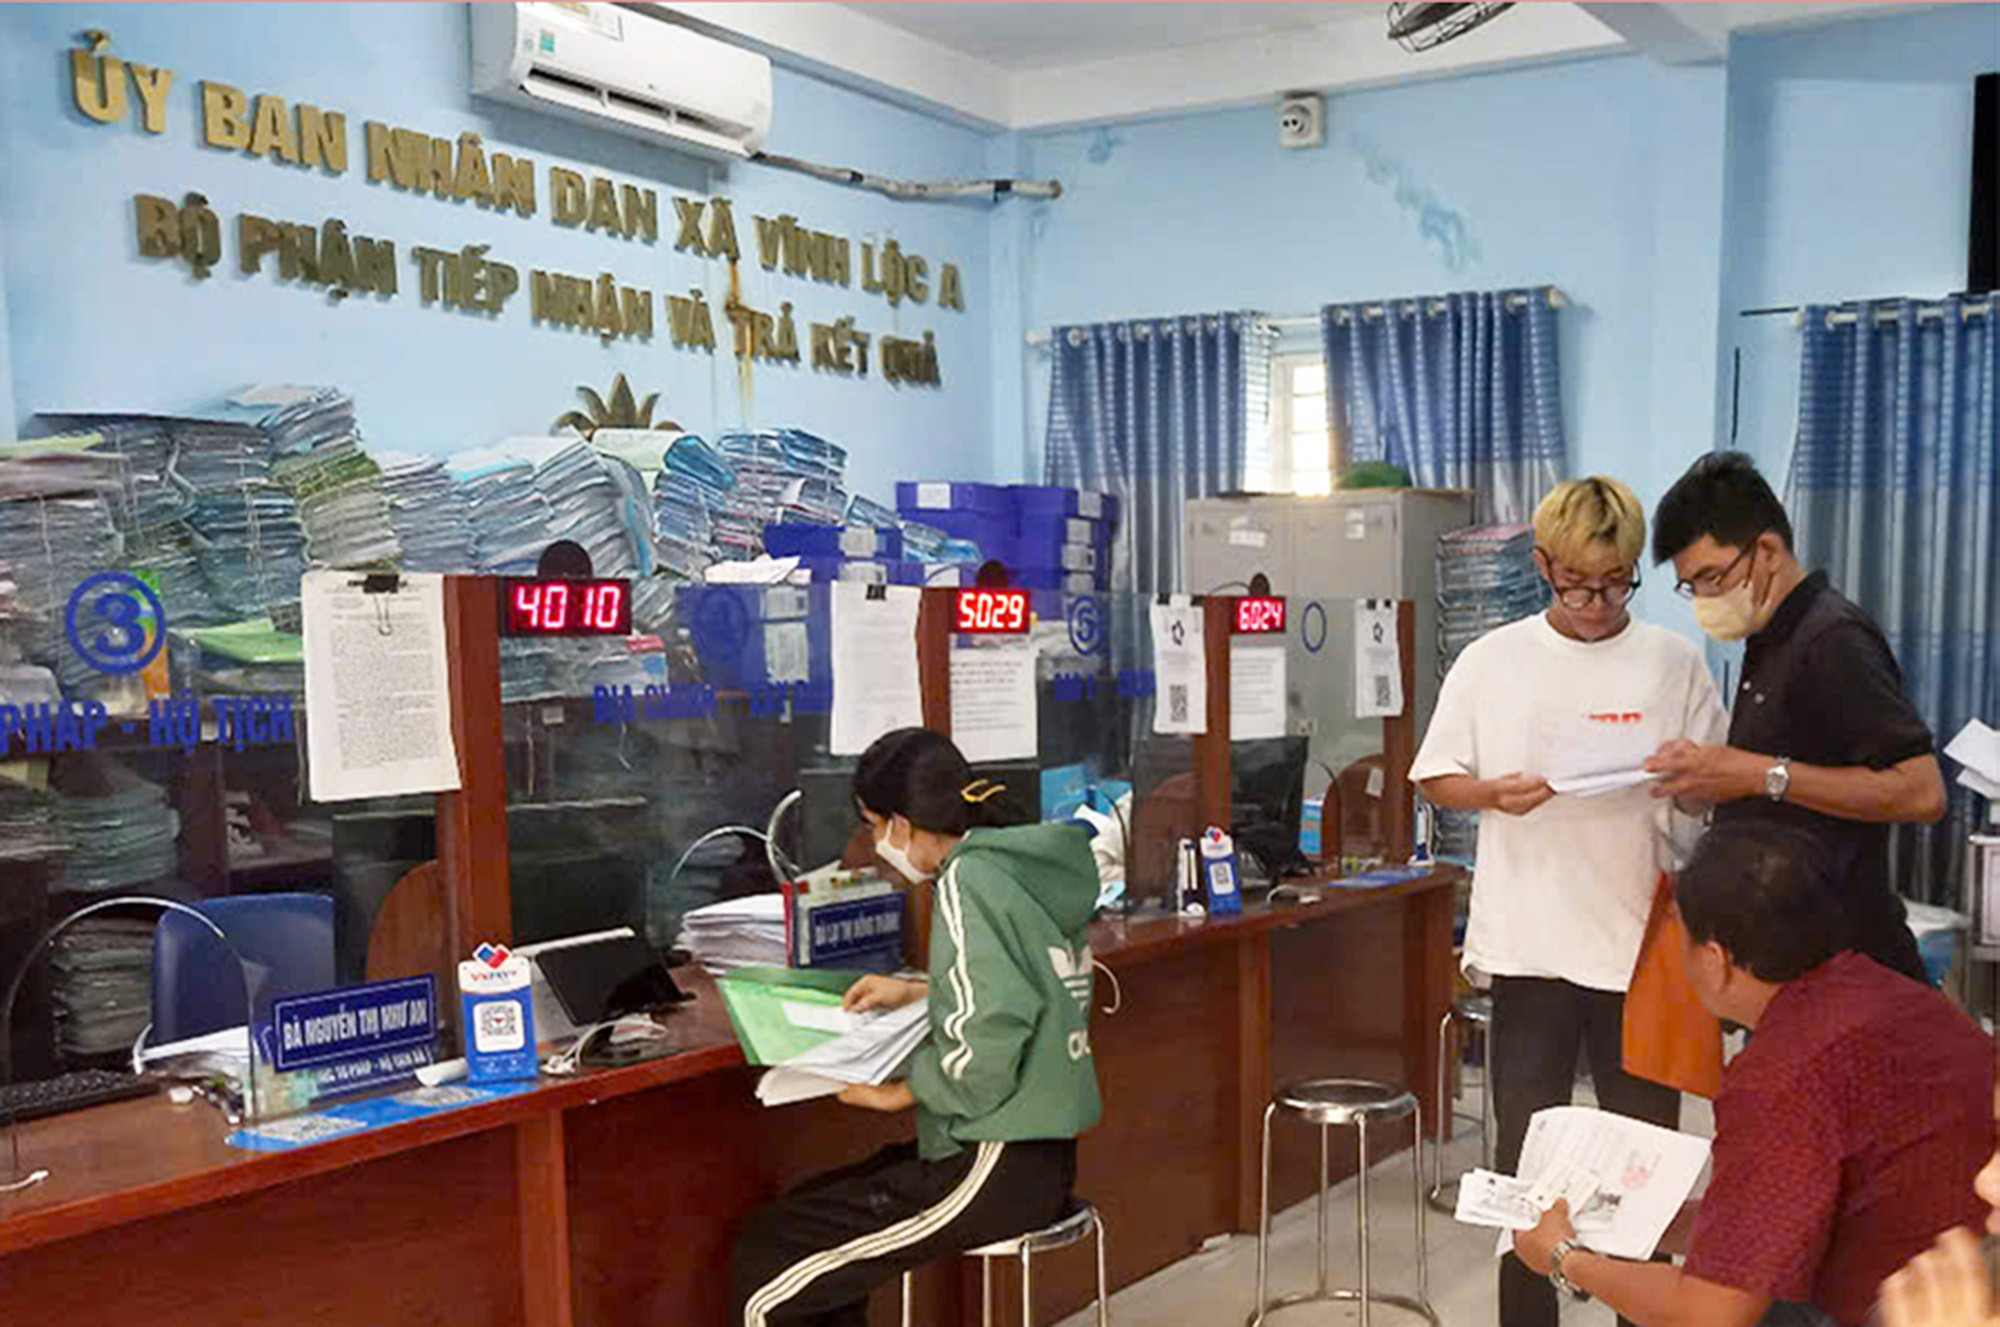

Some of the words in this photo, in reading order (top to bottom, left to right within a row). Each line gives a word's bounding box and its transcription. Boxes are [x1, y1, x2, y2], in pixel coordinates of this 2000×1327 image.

[70, 29, 172, 133] ỦY
[200, 79, 348, 172] BAN
[364, 122, 536, 216] NHÂN
[753, 213, 850, 287] VĨNH
[861, 238, 930, 308] LỘC
[938, 262, 966, 311] A
[134, 191, 220, 279] BỘ
[237, 213, 398, 302] PHẬN
[412, 244, 519, 316] TIẾP
[530, 270, 653, 344] NHẬN
[664, 288, 717, 353] VÀ
[725, 301, 802, 362] TRẢ
[810, 315, 870, 375] KẾT
[93, 591, 146, 657] 3
[516, 584, 622, 630] 4010
[959, 592, 1025, 629] 5029
[1238, 601, 1283, 632] 6024
